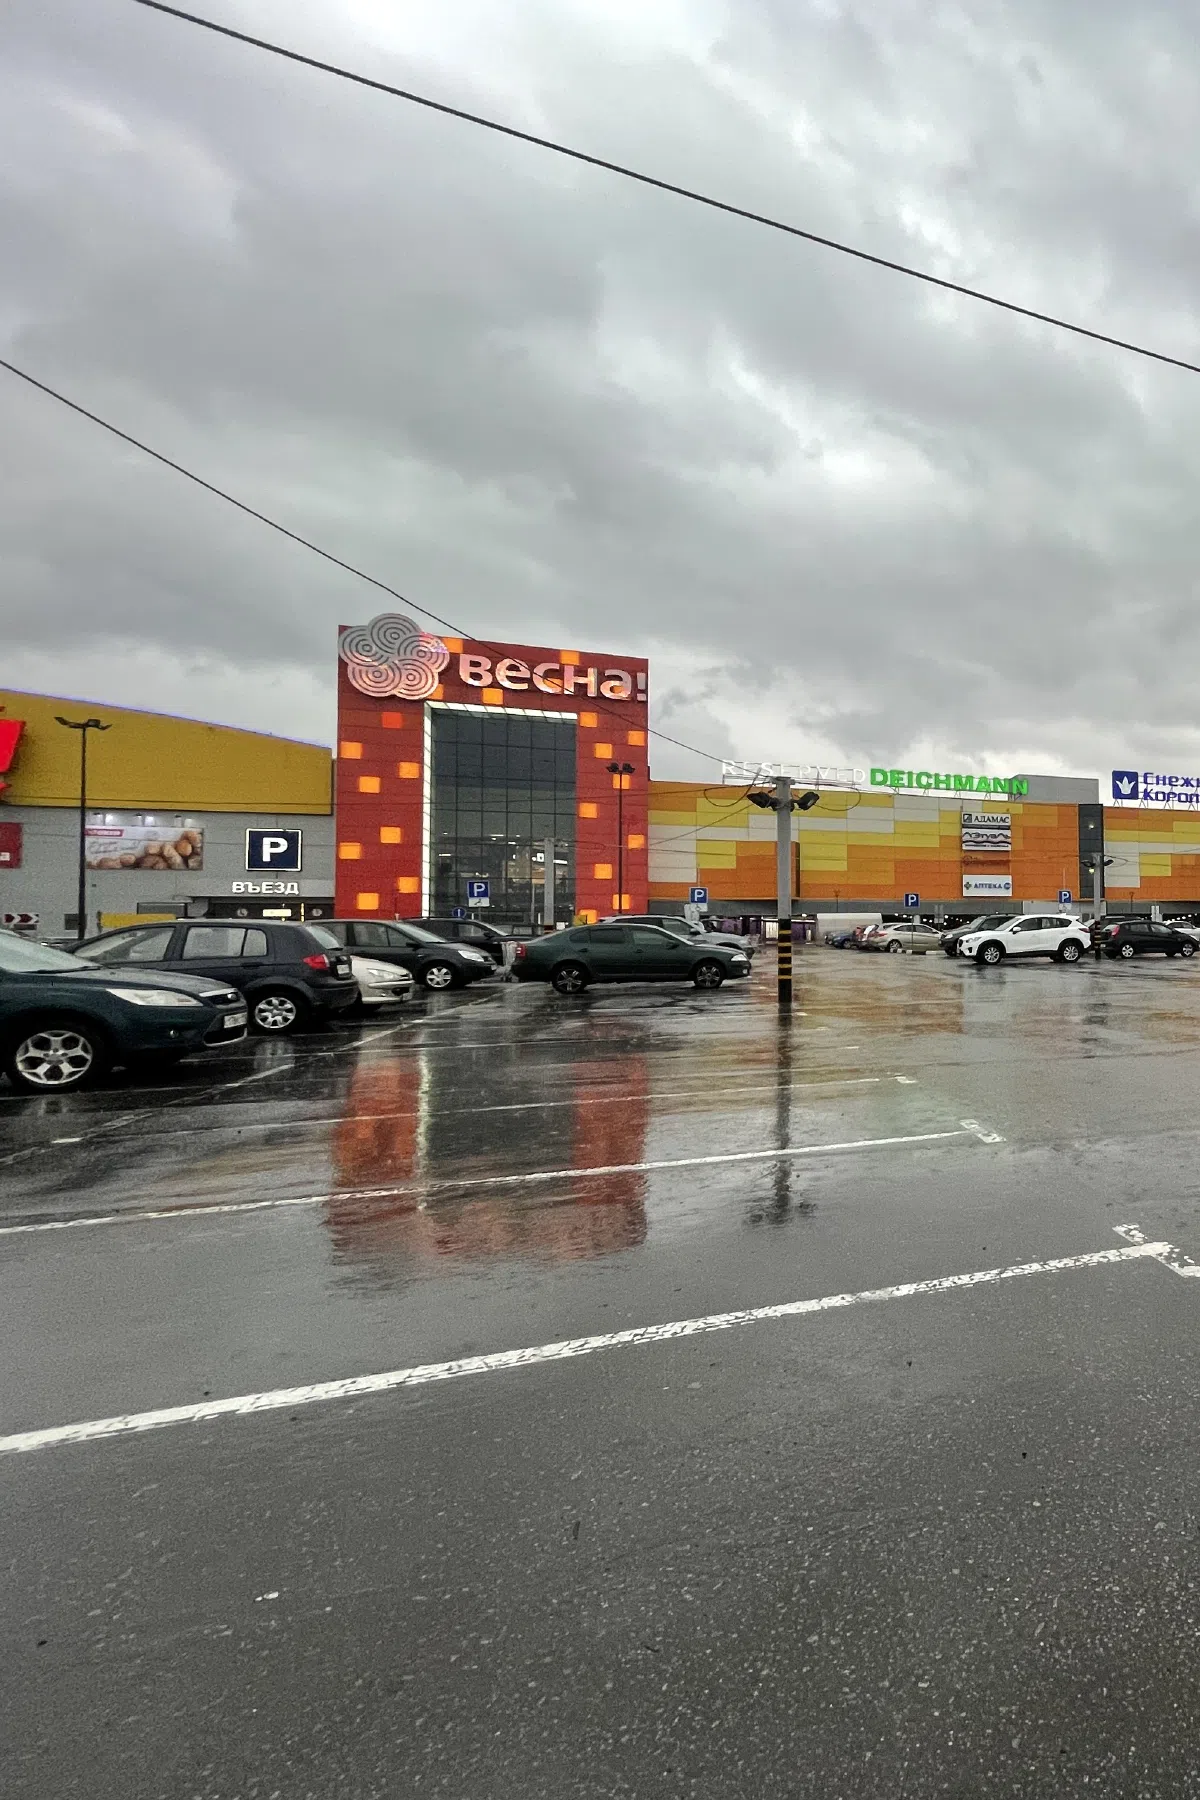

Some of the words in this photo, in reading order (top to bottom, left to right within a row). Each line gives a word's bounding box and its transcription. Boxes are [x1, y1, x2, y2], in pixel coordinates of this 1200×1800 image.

[722, 760, 866, 782] RESERVED
[870, 768, 1029, 795] DEICHMANN
[974, 815, 1010, 824] АДАМАС
[262, 837, 288, 862] P
[231, 881, 299, 895] ВЪЕЗД
